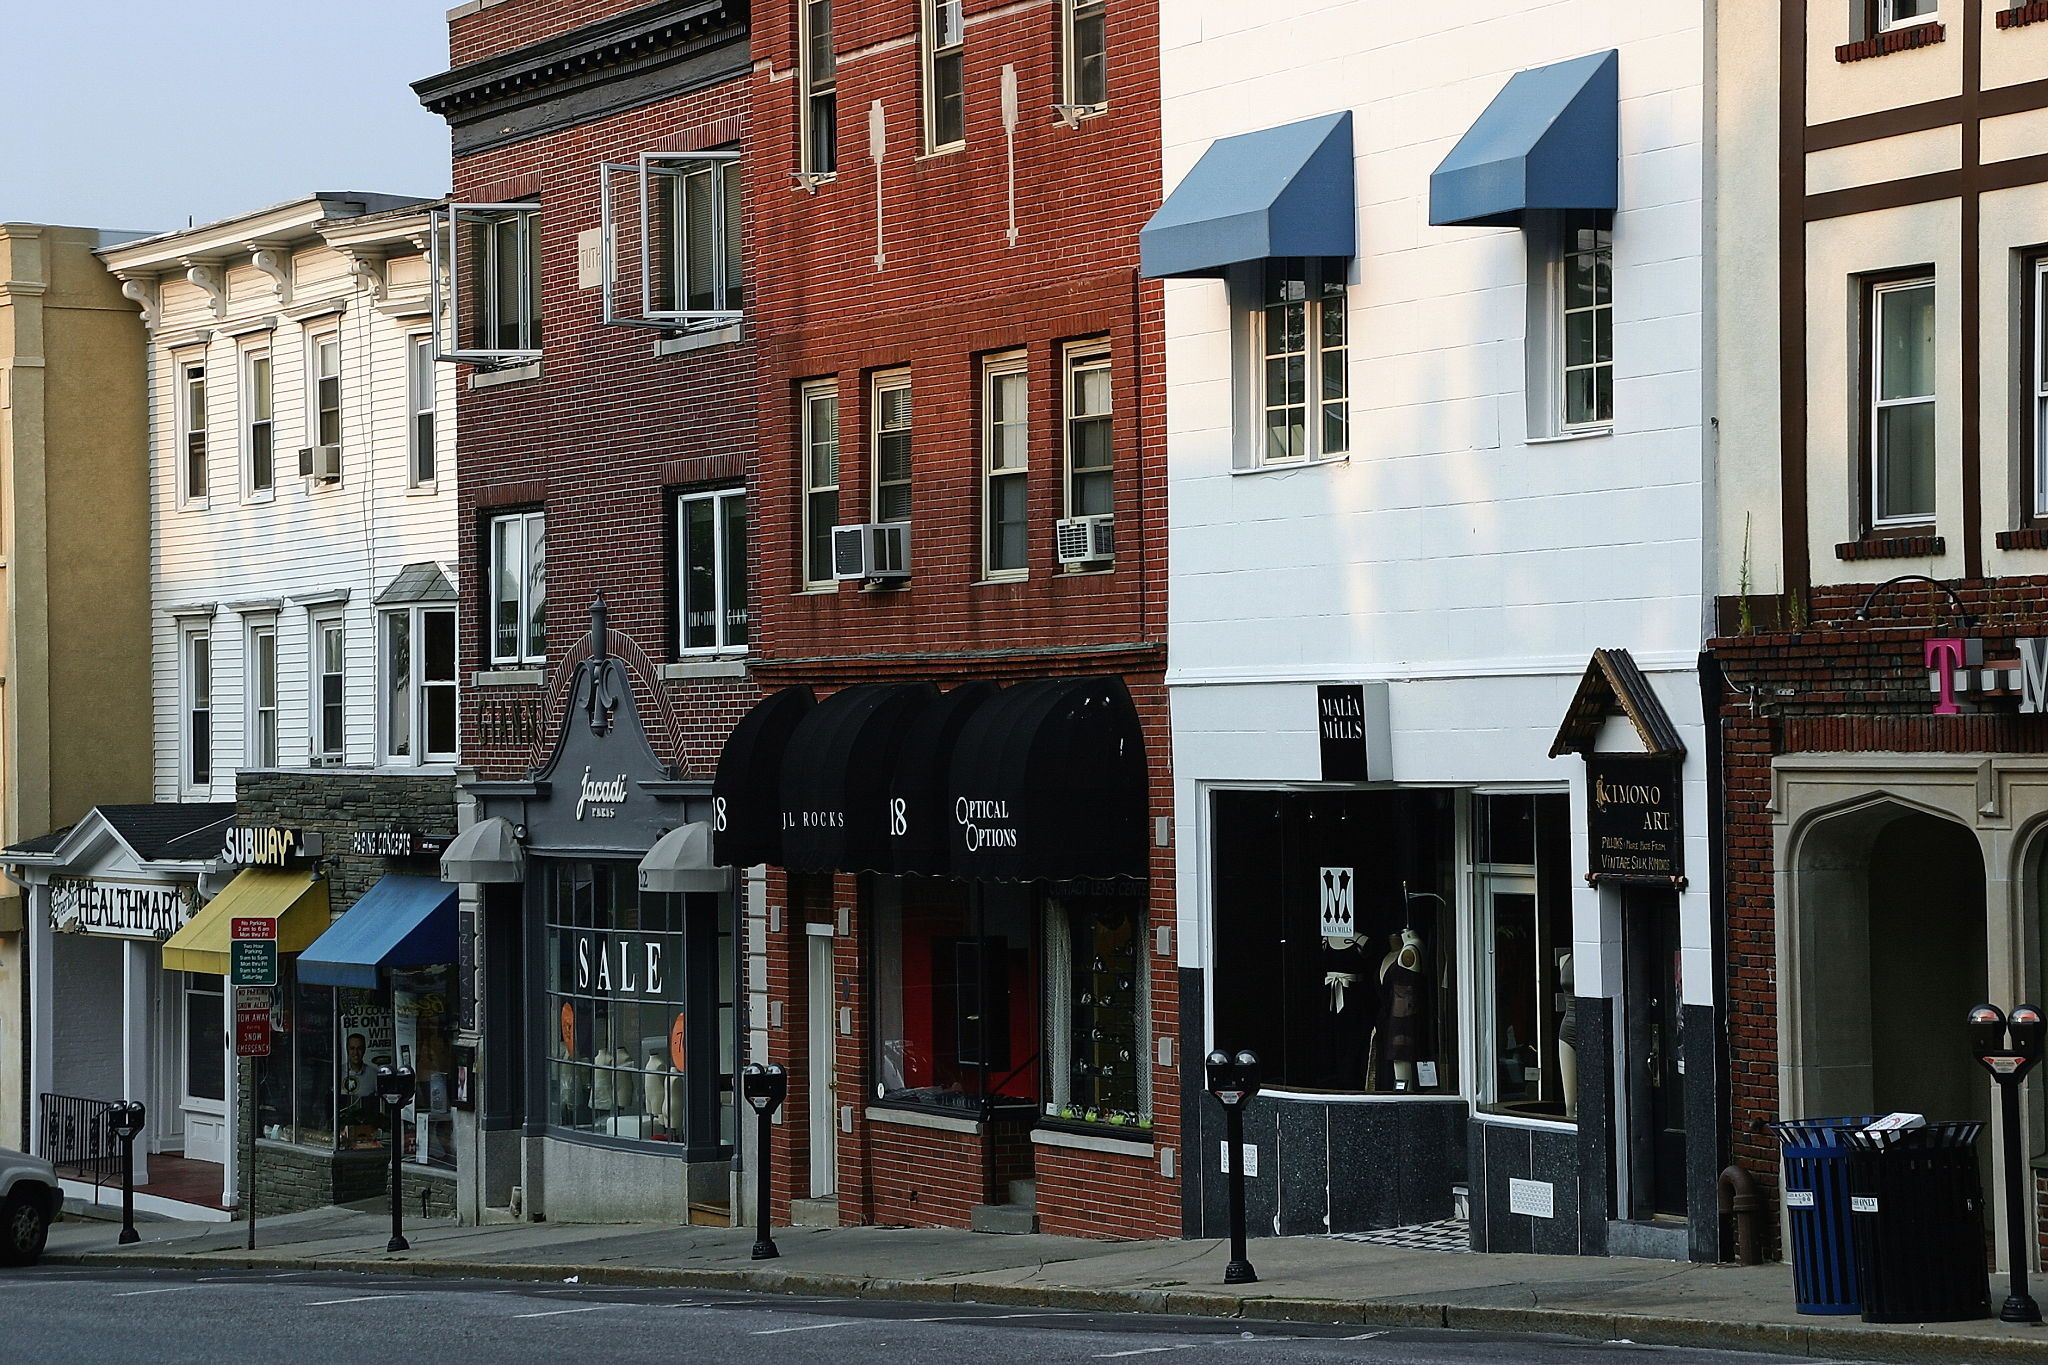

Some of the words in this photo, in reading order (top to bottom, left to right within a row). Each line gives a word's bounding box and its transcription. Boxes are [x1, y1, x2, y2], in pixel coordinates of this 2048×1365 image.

[1596, 775, 1661, 807] KIMONO
[712, 796, 727, 832] 18
[782, 811, 796, 830] JL
[803, 811, 844, 828] ROCKS
[890, 798, 907, 836] 18
[956, 796, 1009, 824] OPTICAL
[1643, 811, 1671, 831] ART
[222, 827, 294, 867] SUBWAY
[966, 824, 1017, 852] OPTIONS
[78, 886, 182, 934] HEALTHMART
[579, 937, 663, 994] SALE
[237, 1013, 250, 1022] TOW
[251, 1013, 269, 1022] AWAY
[343, 1016, 359, 1029] BE
[360, 1015, 380, 1028] ON
[244, 1033, 262, 1041] SNOW
